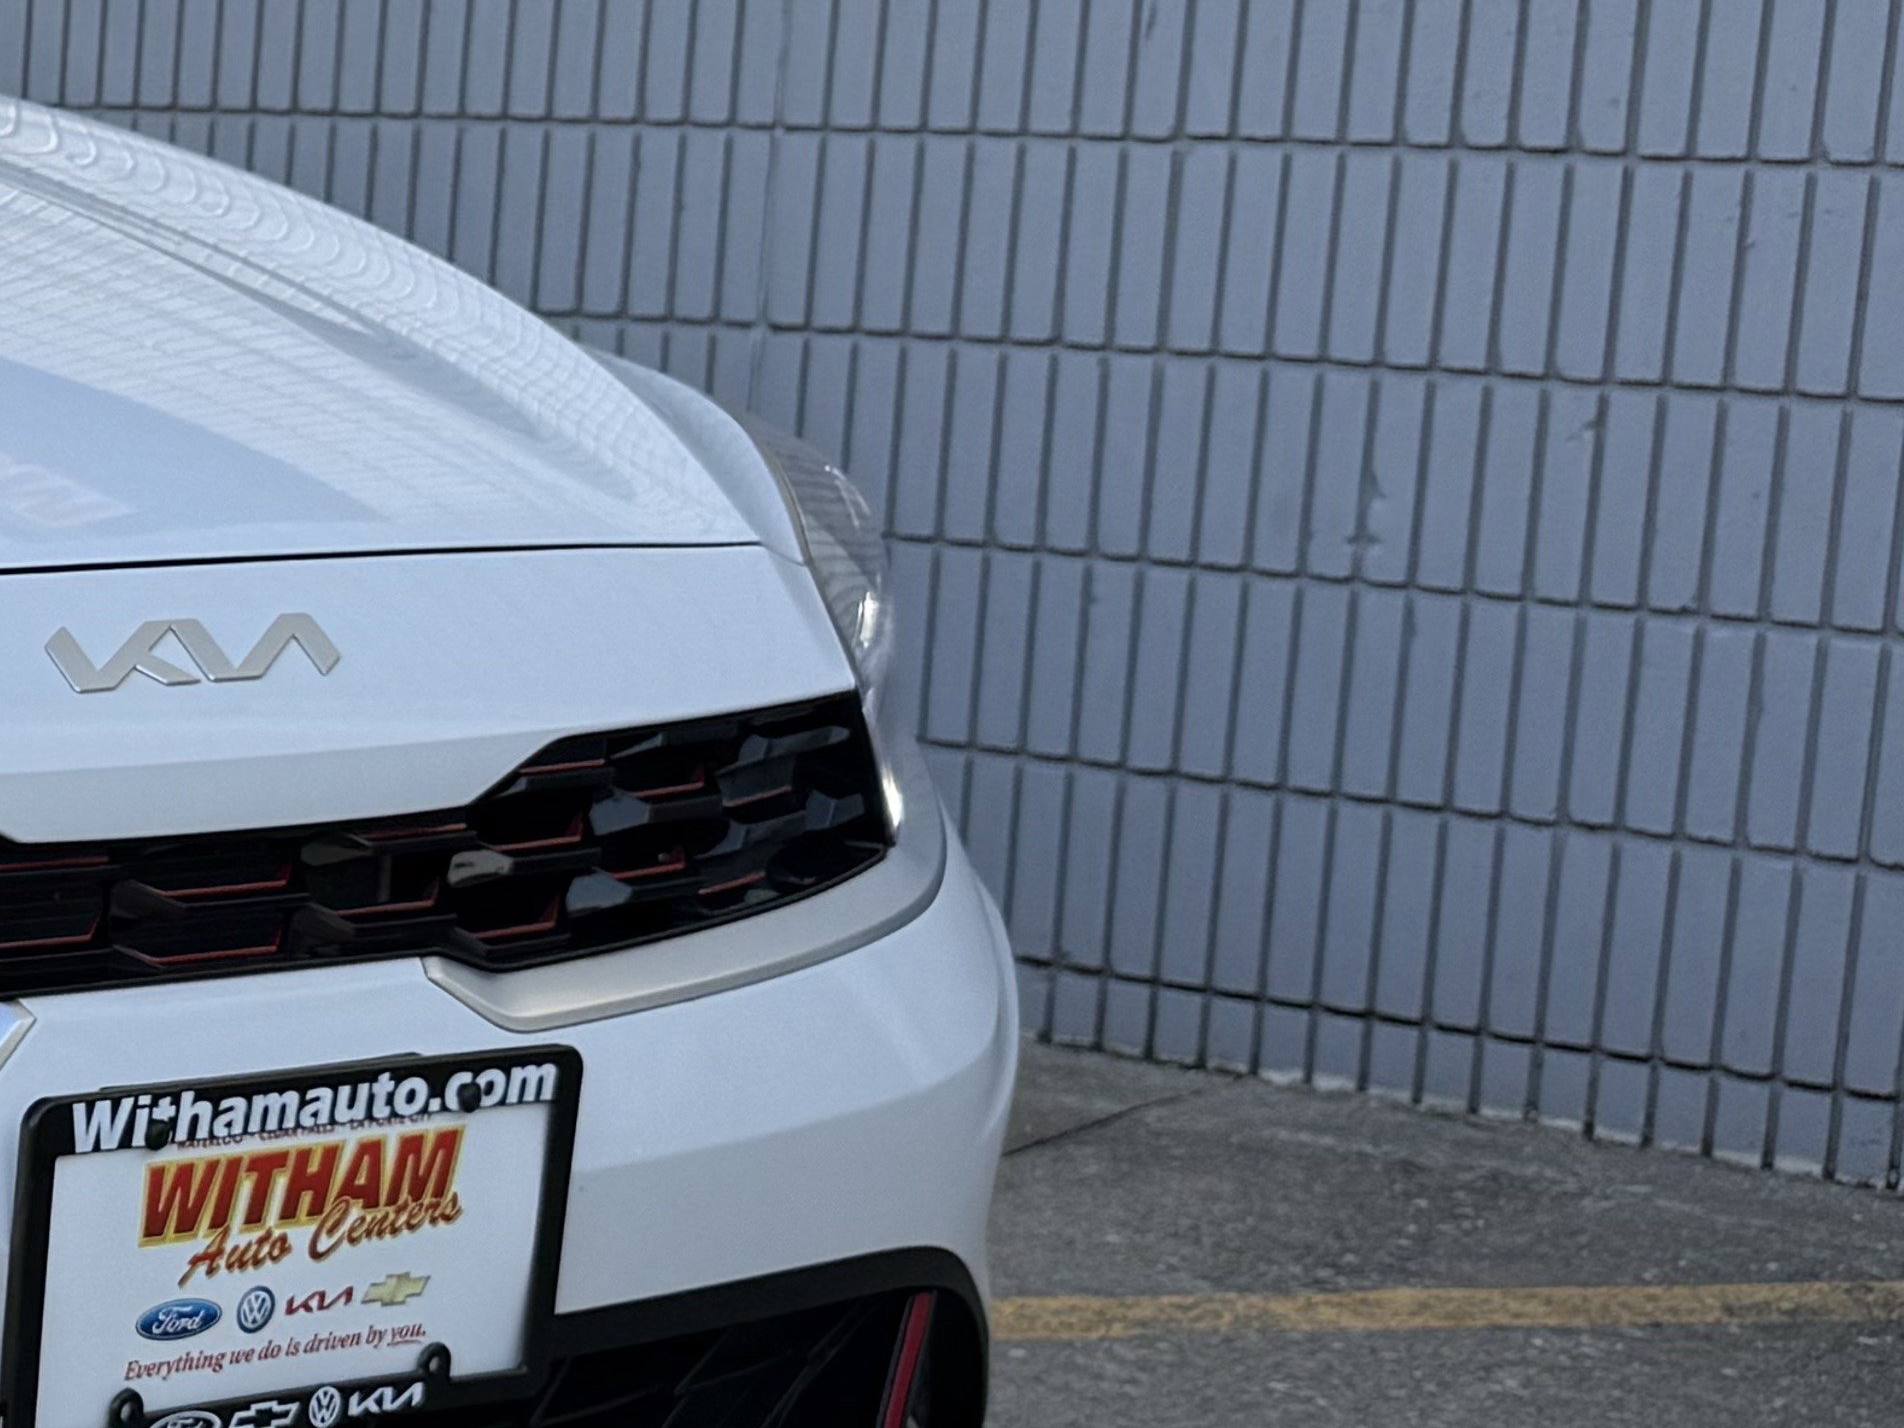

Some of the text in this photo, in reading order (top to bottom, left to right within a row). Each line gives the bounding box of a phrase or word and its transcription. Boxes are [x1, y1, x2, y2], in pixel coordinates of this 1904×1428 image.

[45, 612, 341, 694] KIA
[71, 1061, 559, 1154] Withamauto.com
[138, 1124, 467, 1247] WITHAM
[178, 1189, 463, 1289] Auto Centers
[284, 1285, 354, 1316] KIA
[124, 1323, 426, 1382] Everything we do is driven by you.
